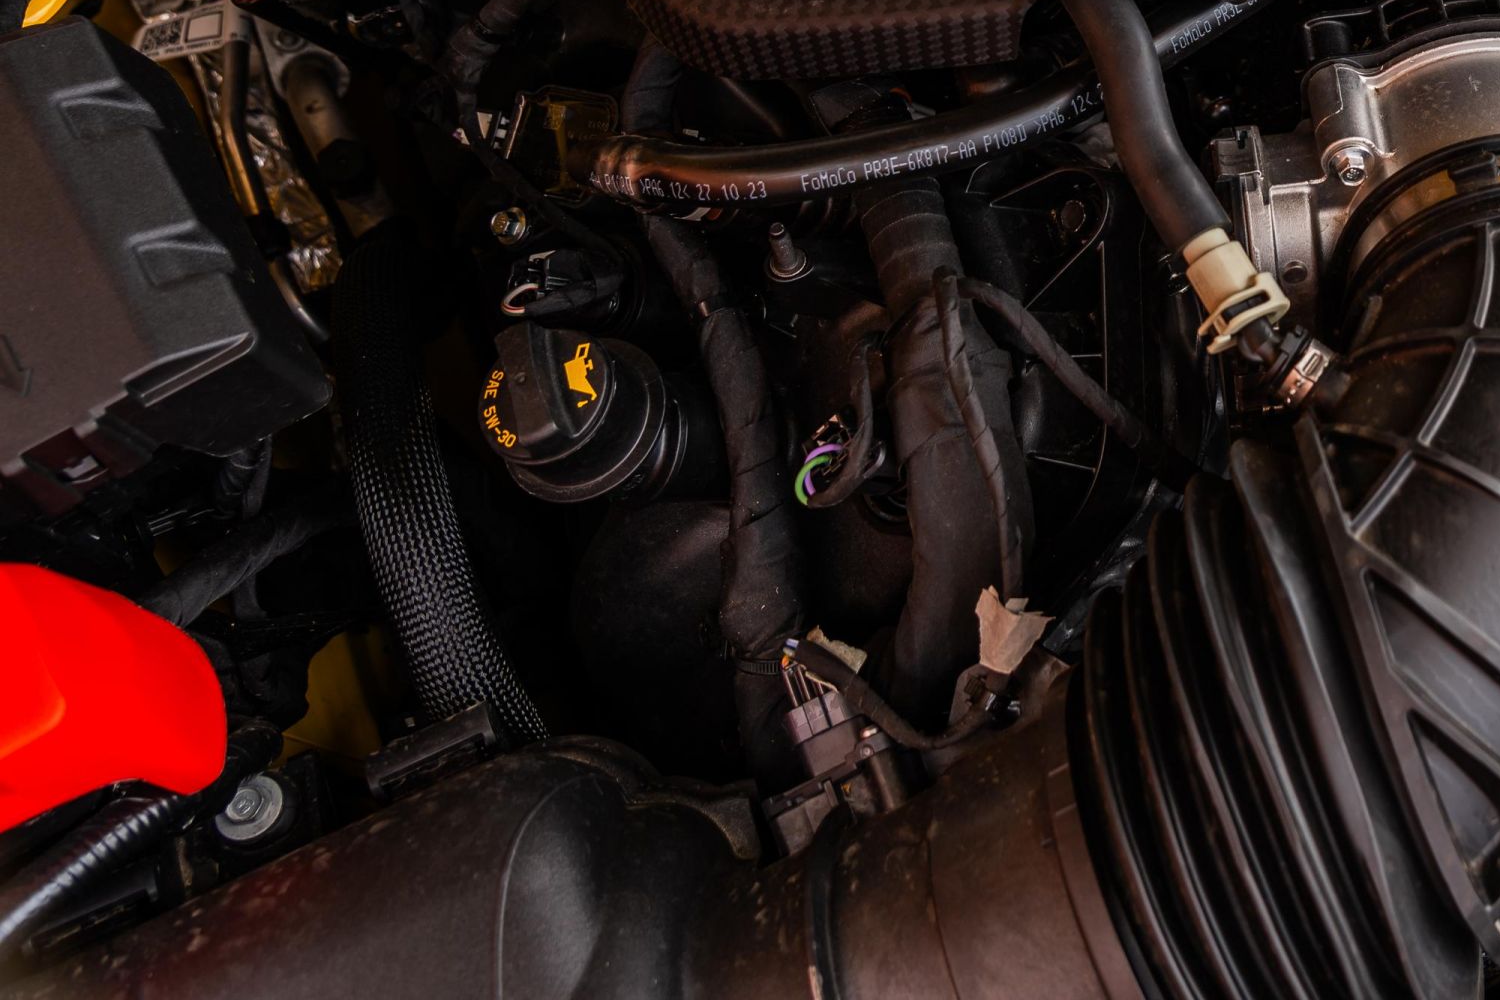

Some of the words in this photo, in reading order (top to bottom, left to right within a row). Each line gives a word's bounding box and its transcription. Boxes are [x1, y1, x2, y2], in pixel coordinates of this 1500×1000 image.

[1170, 20, 1212, 54] FoMoCo
[800, 167, 857, 193] FoMoCo
[863, 139, 977, 181] PR3E-6K817-AA
[983, 123, 1028, 153] P108D
[483, 369, 504, 400] SAE
[483, 405, 517, 448] 5W-30
